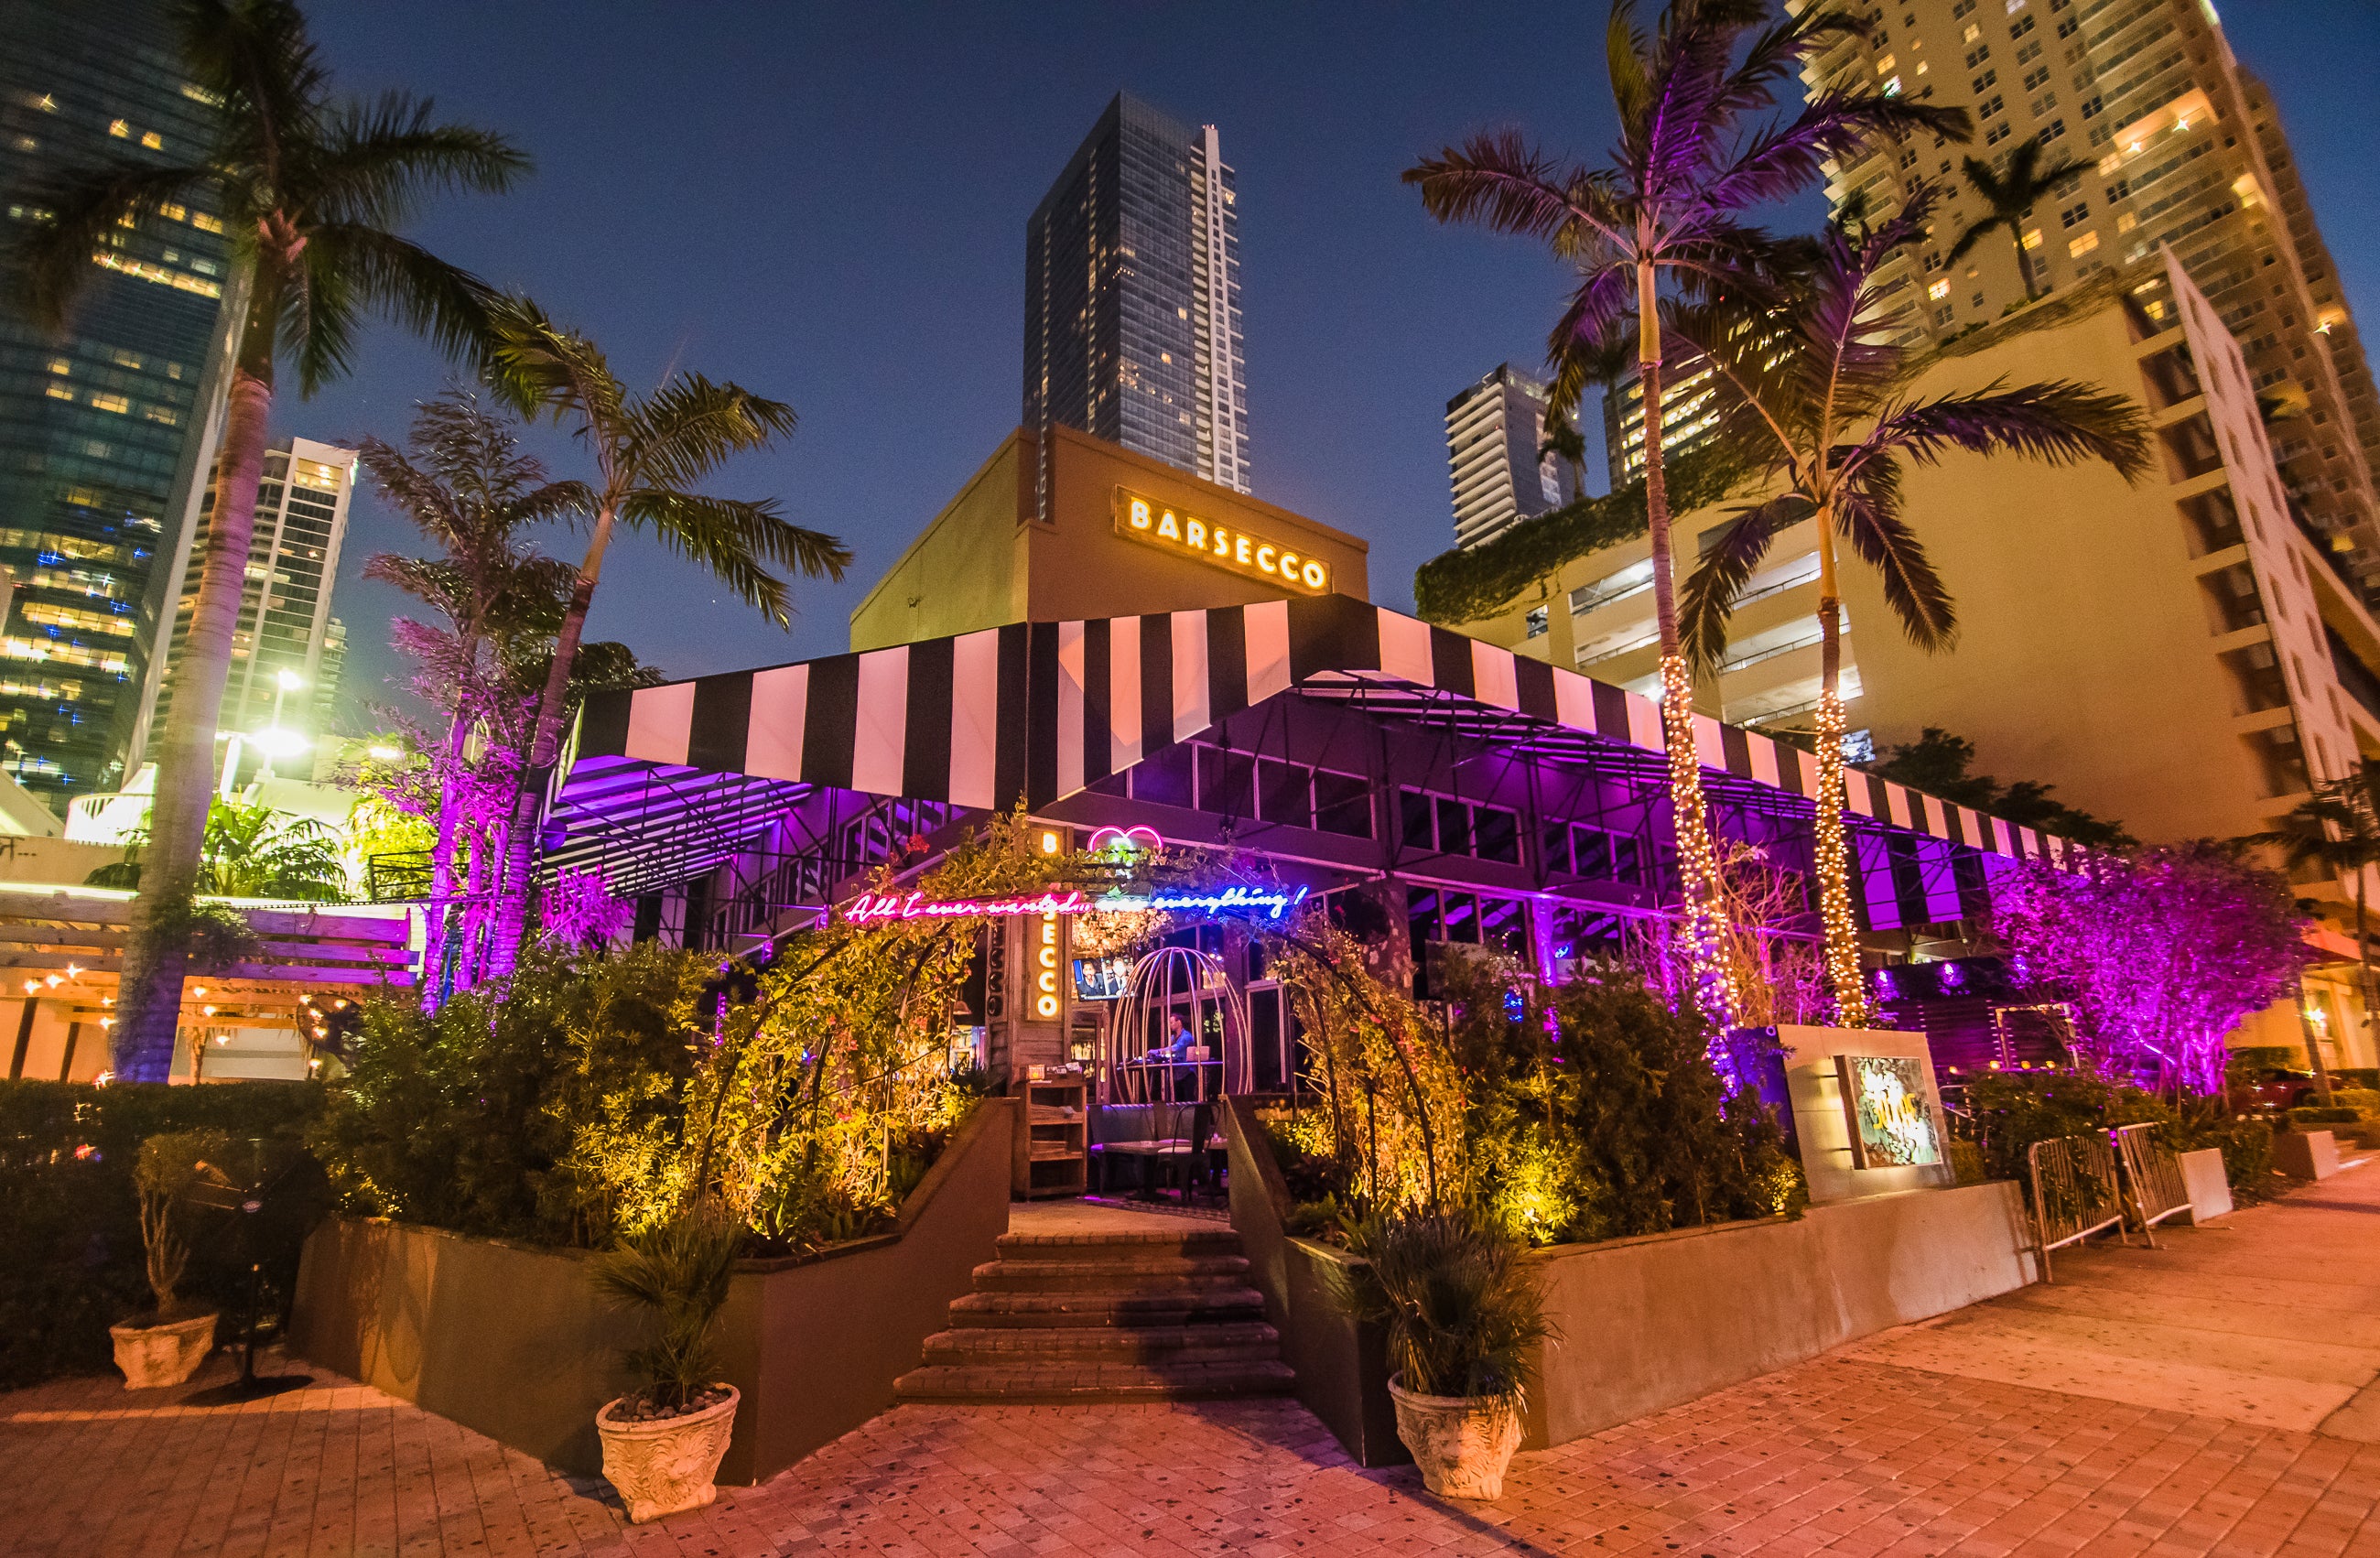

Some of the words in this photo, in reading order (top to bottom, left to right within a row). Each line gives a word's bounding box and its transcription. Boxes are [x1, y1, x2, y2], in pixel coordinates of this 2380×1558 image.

[1130, 496, 1327, 589] BARSECCO
[845, 893, 898, 923] All
[925, 901, 982, 915] ever
